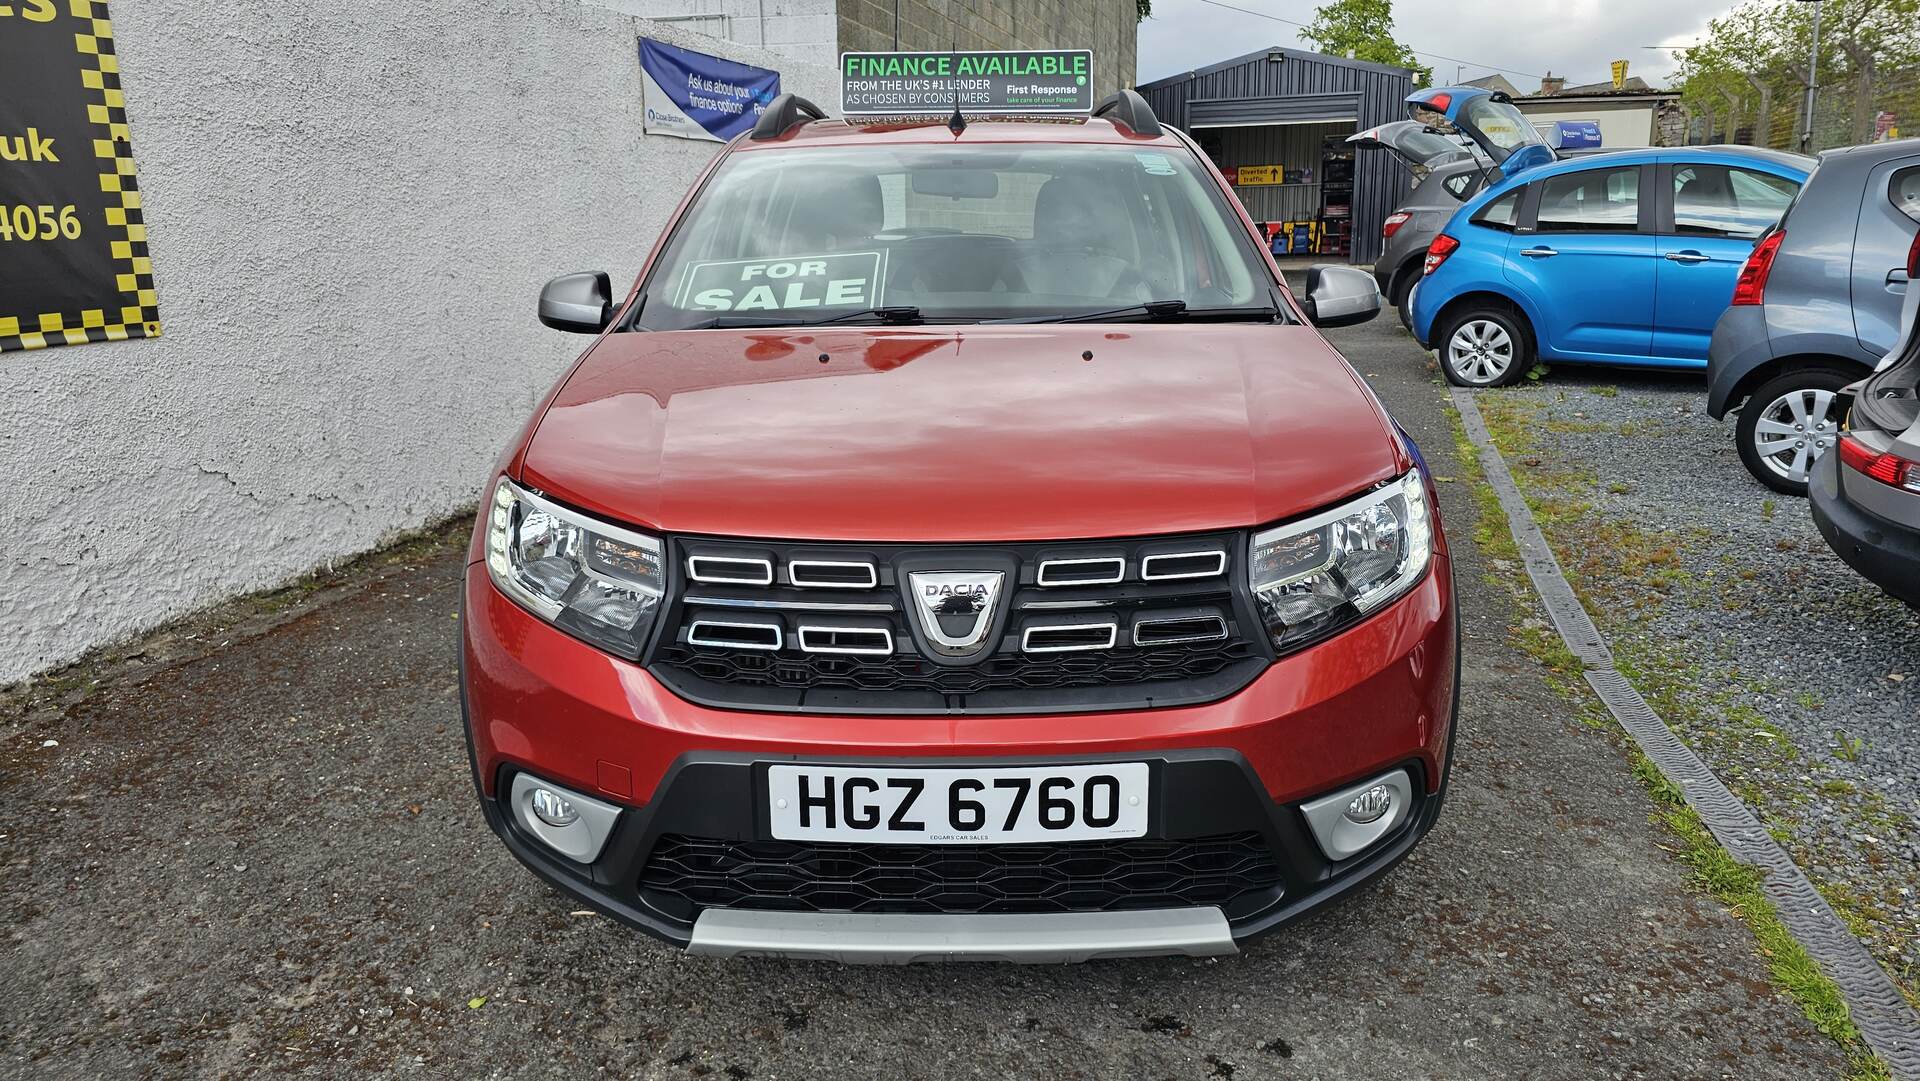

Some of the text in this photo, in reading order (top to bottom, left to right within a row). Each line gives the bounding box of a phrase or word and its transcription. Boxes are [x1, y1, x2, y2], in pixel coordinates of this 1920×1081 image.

[847, 56, 1087, 77] FINANCE AVAILABLE
[688, 73, 703, 90] Ask
[703, 80, 712, 92] us
[714, 80, 734, 96] about
[734, 86, 750, 100] your
[846, 79, 991, 91] FROM THE UK'S #1 LENDER
[1006, 84, 1078, 96] First Response
[689, 92, 744, 115] finance options
[846, 92, 990, 104] AS CHOSEN BY CONSUMERS
[740, 261, 827, 281] FOR
[688, 278, 866, 311] SALE
[925, 584, 988, 596] DACIA
[797, 774, 1121, 832] HGZ 6760
